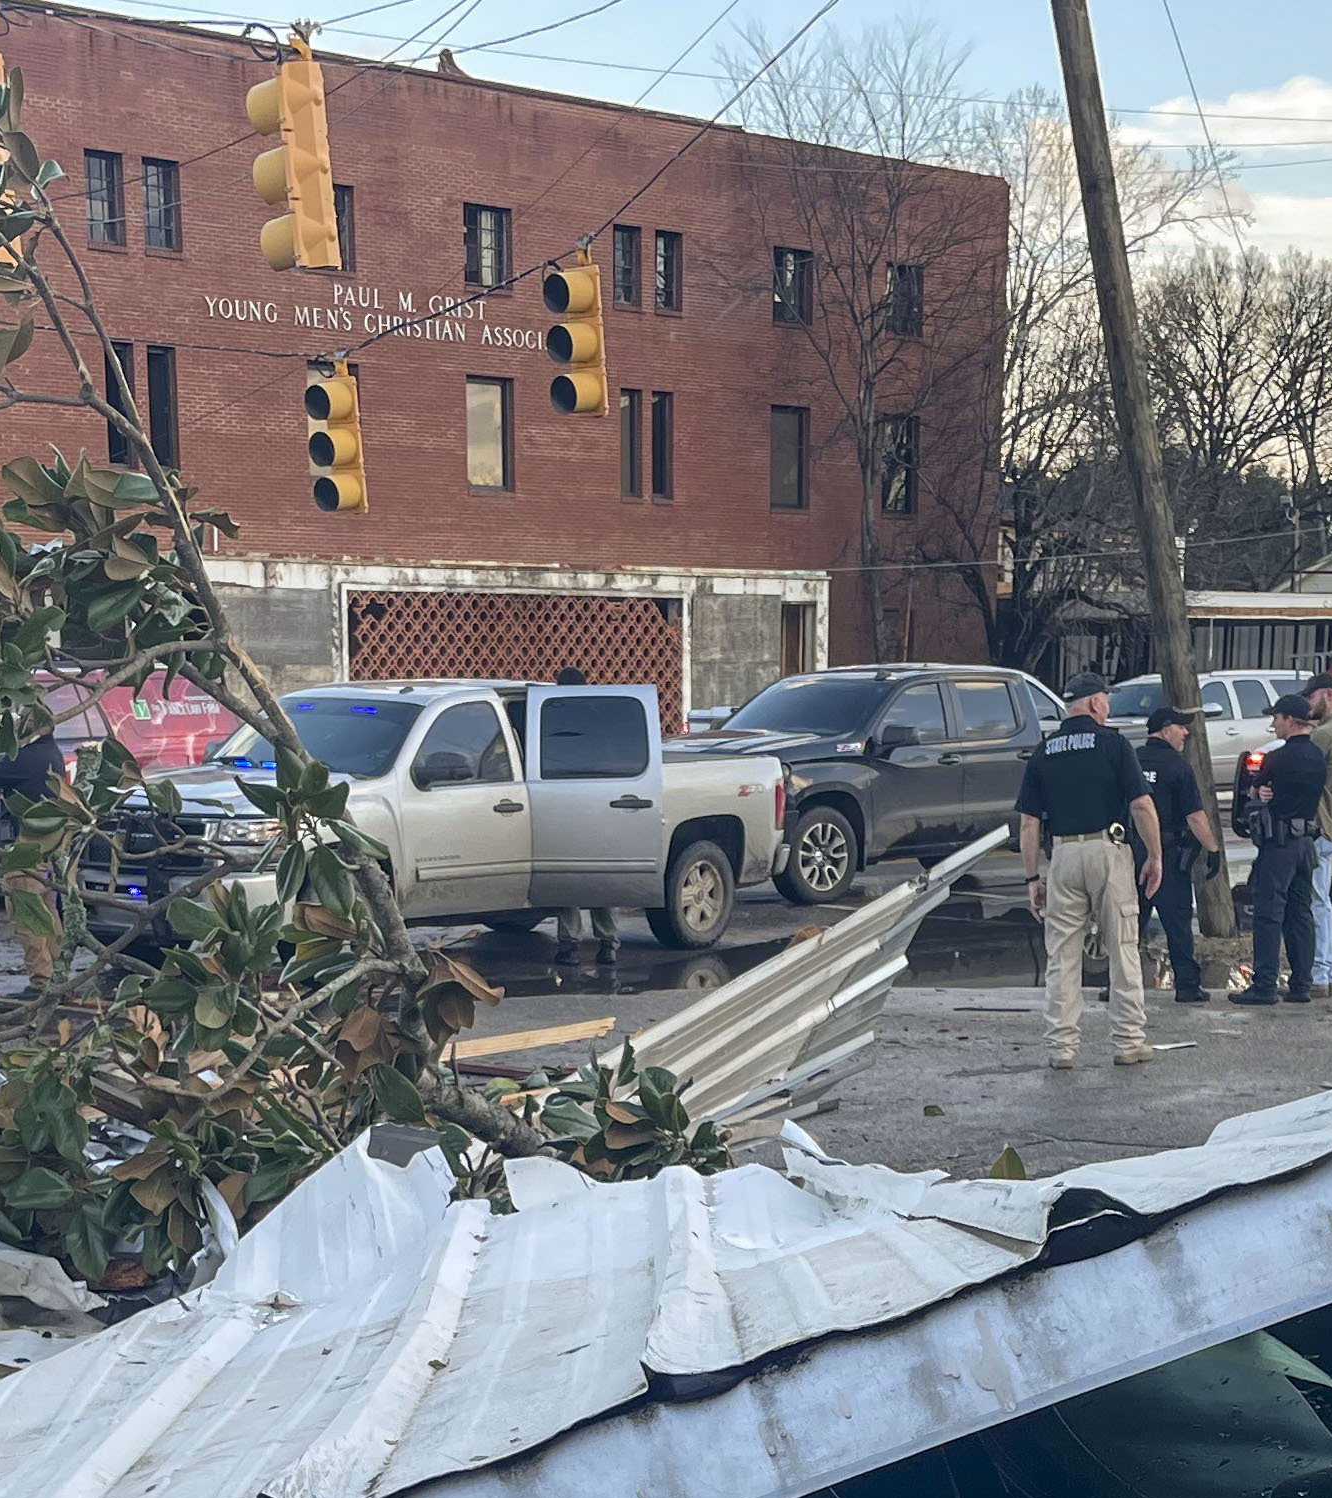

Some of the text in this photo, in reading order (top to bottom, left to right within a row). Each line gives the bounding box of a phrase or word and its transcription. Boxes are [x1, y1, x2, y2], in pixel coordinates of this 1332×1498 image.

[333, 284, 487, 321] PAUL M. GRIST
[204, 296, 548, 350] YOUNG MEN'S CHRISTIAN ASSOCI
[1045, 733, 1096, 755] STATE POLICE
